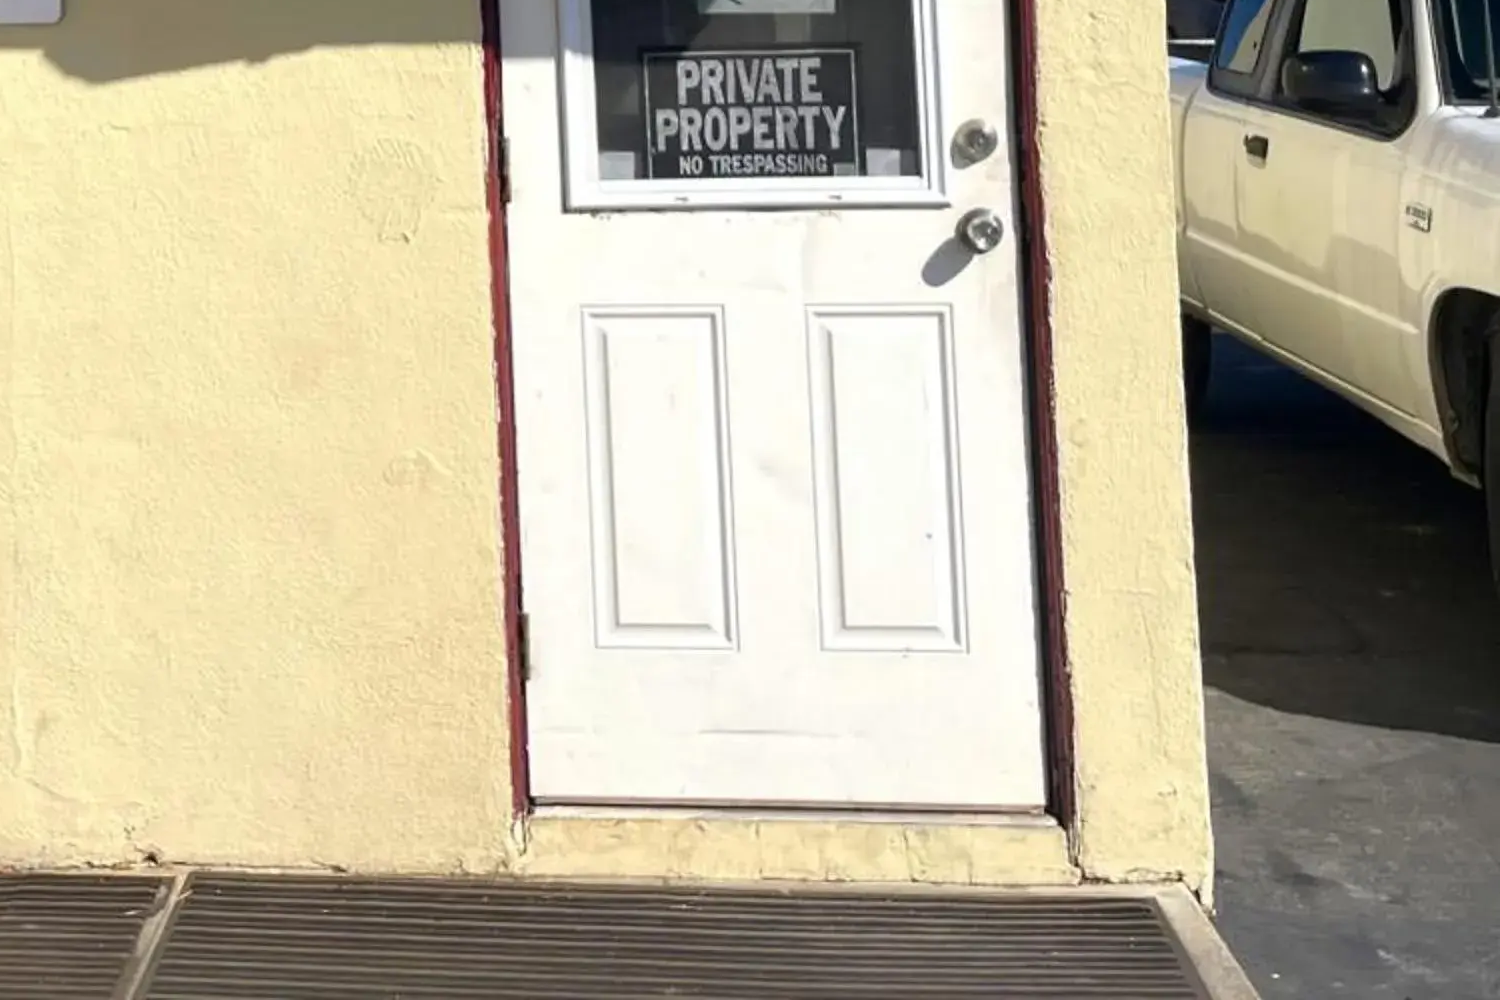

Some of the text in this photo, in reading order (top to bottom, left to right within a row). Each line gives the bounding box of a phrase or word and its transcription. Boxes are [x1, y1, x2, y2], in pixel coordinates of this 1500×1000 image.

[676, 57, 823, 105] PRIVATE
[655, 105, 847, 153] PROPERTY
[679, 153, 828, 176] NO TRESPASSING
